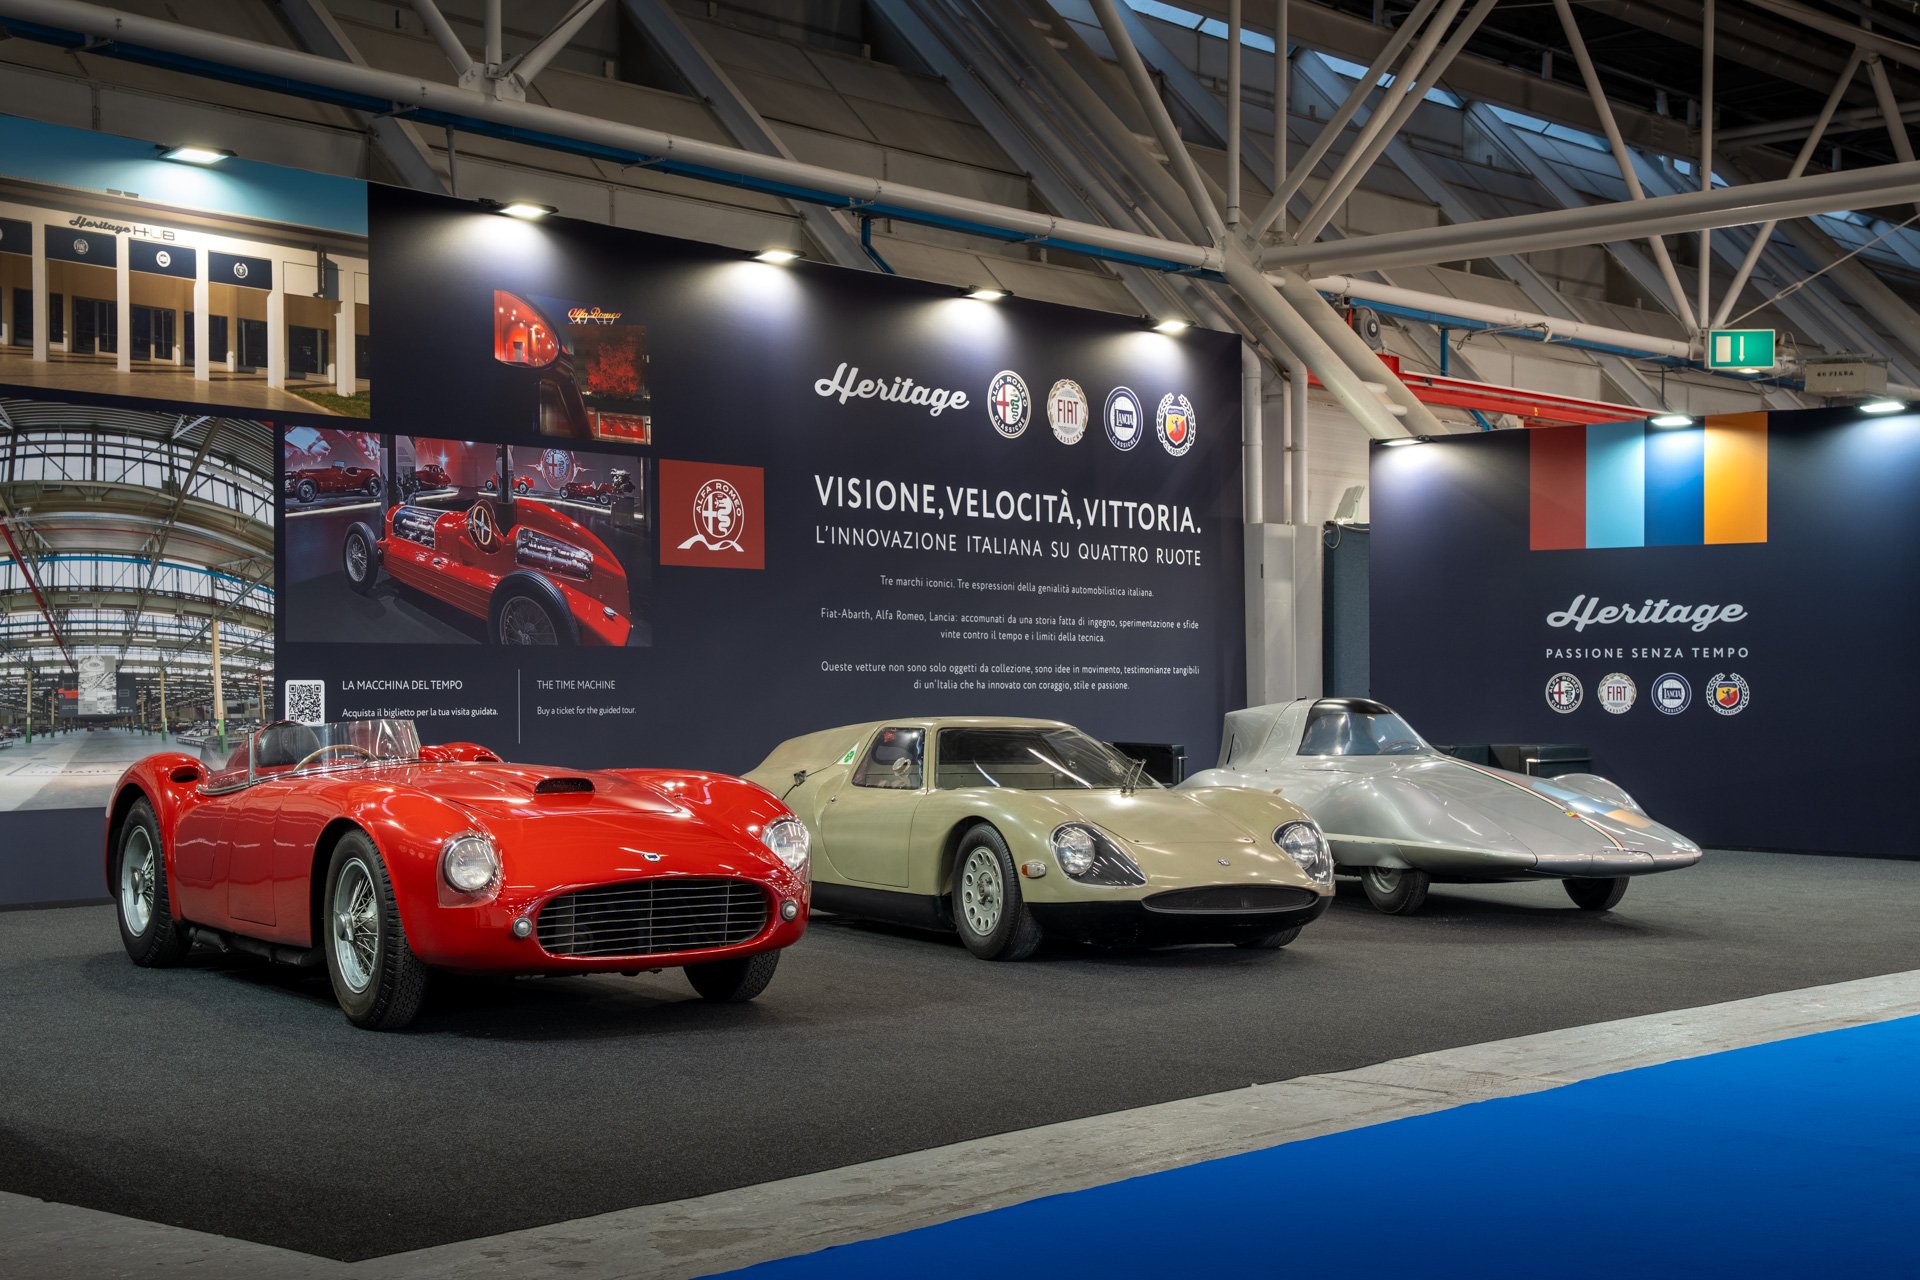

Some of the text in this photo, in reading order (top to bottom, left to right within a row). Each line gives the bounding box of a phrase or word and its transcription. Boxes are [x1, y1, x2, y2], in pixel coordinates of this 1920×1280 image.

[69, 216, 175, 240] Heritage HUB
[568, 306, 622, 319] Alfa Romeo
[814, 362, 970, 417] Heritage
[991, 376, 1028, 408] ALFA ROMEO
[1057, 399, 1079, 425] FIAT
[1116, 409, 1134, 428] LANCIA
[994, 414, 1026, 434] CLASSICHE
[1053, 428, 1084, 445] CLASSICHE
[1111, 436, 1137, 450] CLASSICHE
[1164, 441, 1190, 456] CLASSICHE
[695, 482, 742, 518] ALFA ROMEO
[814, 474, 1202, 534] VISIONE, VELOCITÀ, VITTORIA.
[967, 536, 1042, 556] ITALIANA
[1051, 541, 1069, 558] SU
[1078, 543, 1148, 563] QUATTRO
[1156, 548, 1201, 566] RUOTE
[880, 575, 1154, 597] Tre marchi iconici. Tre espressioni della genialità automobilistica italiana.
[821, 608, 873, 620] Fiat-Abarth,
[876, 610, 893, 620] Alfa
[896, 610, 926, 622] Romeo,
[929, 612, 958, 622] Lancia:
[961, 614, 1004, 624] accomunati
[1008, 614, 1016, 624] da
[1035, 617, 1056, 625] storia
[1058, 616, 1076, 626] fatta
[1078, 616, 1085, 626] di
[1088, 618, 1118, 629] ingegno,
[1119, 619, 1175, 629] sperimentazione
[1182, 619, 1199, 629] sfide
[1546, 594, 1748, 632] Heritage
[940, 631, 961, 639] vinte
[963, 632, 989, 640] contro
[991, 630, 996, 640] il
[998, 632, 1022, 642] tempo
[1036, 632, 1056, 641] limiti
[1058, 632, 1076, 642] della
[1078, 633, 1106, 642] tecnica.
[1546, 647, 1748, 658] PASSIONE SENZA TEMPO
[821, 660, 1200, 676] Queste vetture non sono solo oggetti da collezione, sono idee in movimento, testimonianze tangibili
[342, 680, 463, 690] LA MACCHINA DEL TEMPO
[537, 680, 615, 690] THE TIME MACHINE
[914, 680, 922, 689] di
[960, 680, 974, 689] che
[976, 680, 986, 689] ha
[988, 682, 1021, 690] innovato
[1022, 682, 1036, 690] con
[1038, 680, 1072, 692] coraggio,
[1073, 680, 1090, 690] stile
[1091, 682, 1096, 690] e
[1098, 681, 1130, 691] passione.
[1549, 676, 1580, 694] ALFA ROMEO
[1607, 686, 1627, 702] FIAT
[1662, 687, 1682, 700] LANCIA
[342, 708, 376, 719] Acquista
[377, 708, 382, 717] il
[384, 708, 415, 719] biglietto
[416, 710, 429, 718] per
[430, 708, 437, 716] la
[451, 708, 470, 716] visita
[471, 707, 498, 718] guidata.
[537, 706, 550, 716] Buy
[556, 706, 575, 715] ticket
[576, 706, 586, 714] for
[586, 706, 598, 714] the
[598, 706, 621, 716] guided
[1551, 699, 1579, 712] CLASSICHE
[1659, 704, 1685, 715] CLASSICHE
